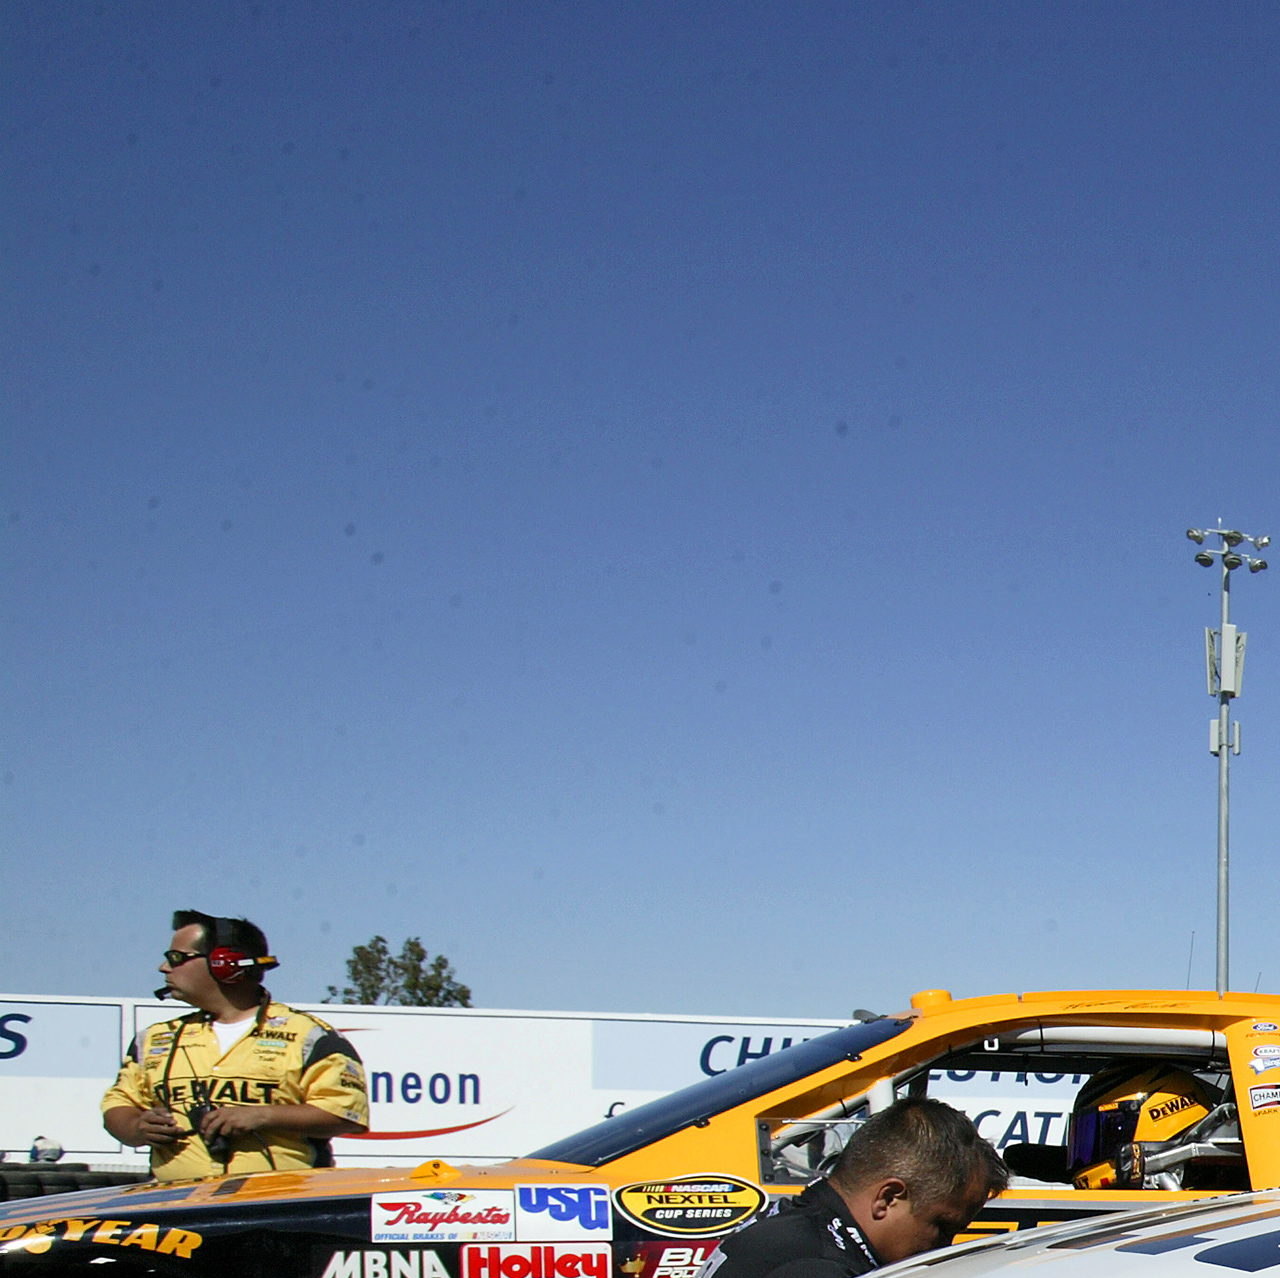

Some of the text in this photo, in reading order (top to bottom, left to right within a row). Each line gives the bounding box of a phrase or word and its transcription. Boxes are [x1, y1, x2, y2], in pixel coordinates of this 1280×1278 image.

[671, 1184, 733, 1193] NASCAR
[647, 1194, 737, 1205] NEXTEL
[519, 1187, 610, 1230] USG
[655, 1208, 732, 1219] CUP SERIES
[376, 1201, 511, 1231] Raybestos
[375, 1232, 411, 1241] OFFICIAL
[413, 1232, 445, 1240] BRAKES
[448, 1232, 458, 1240] OF
